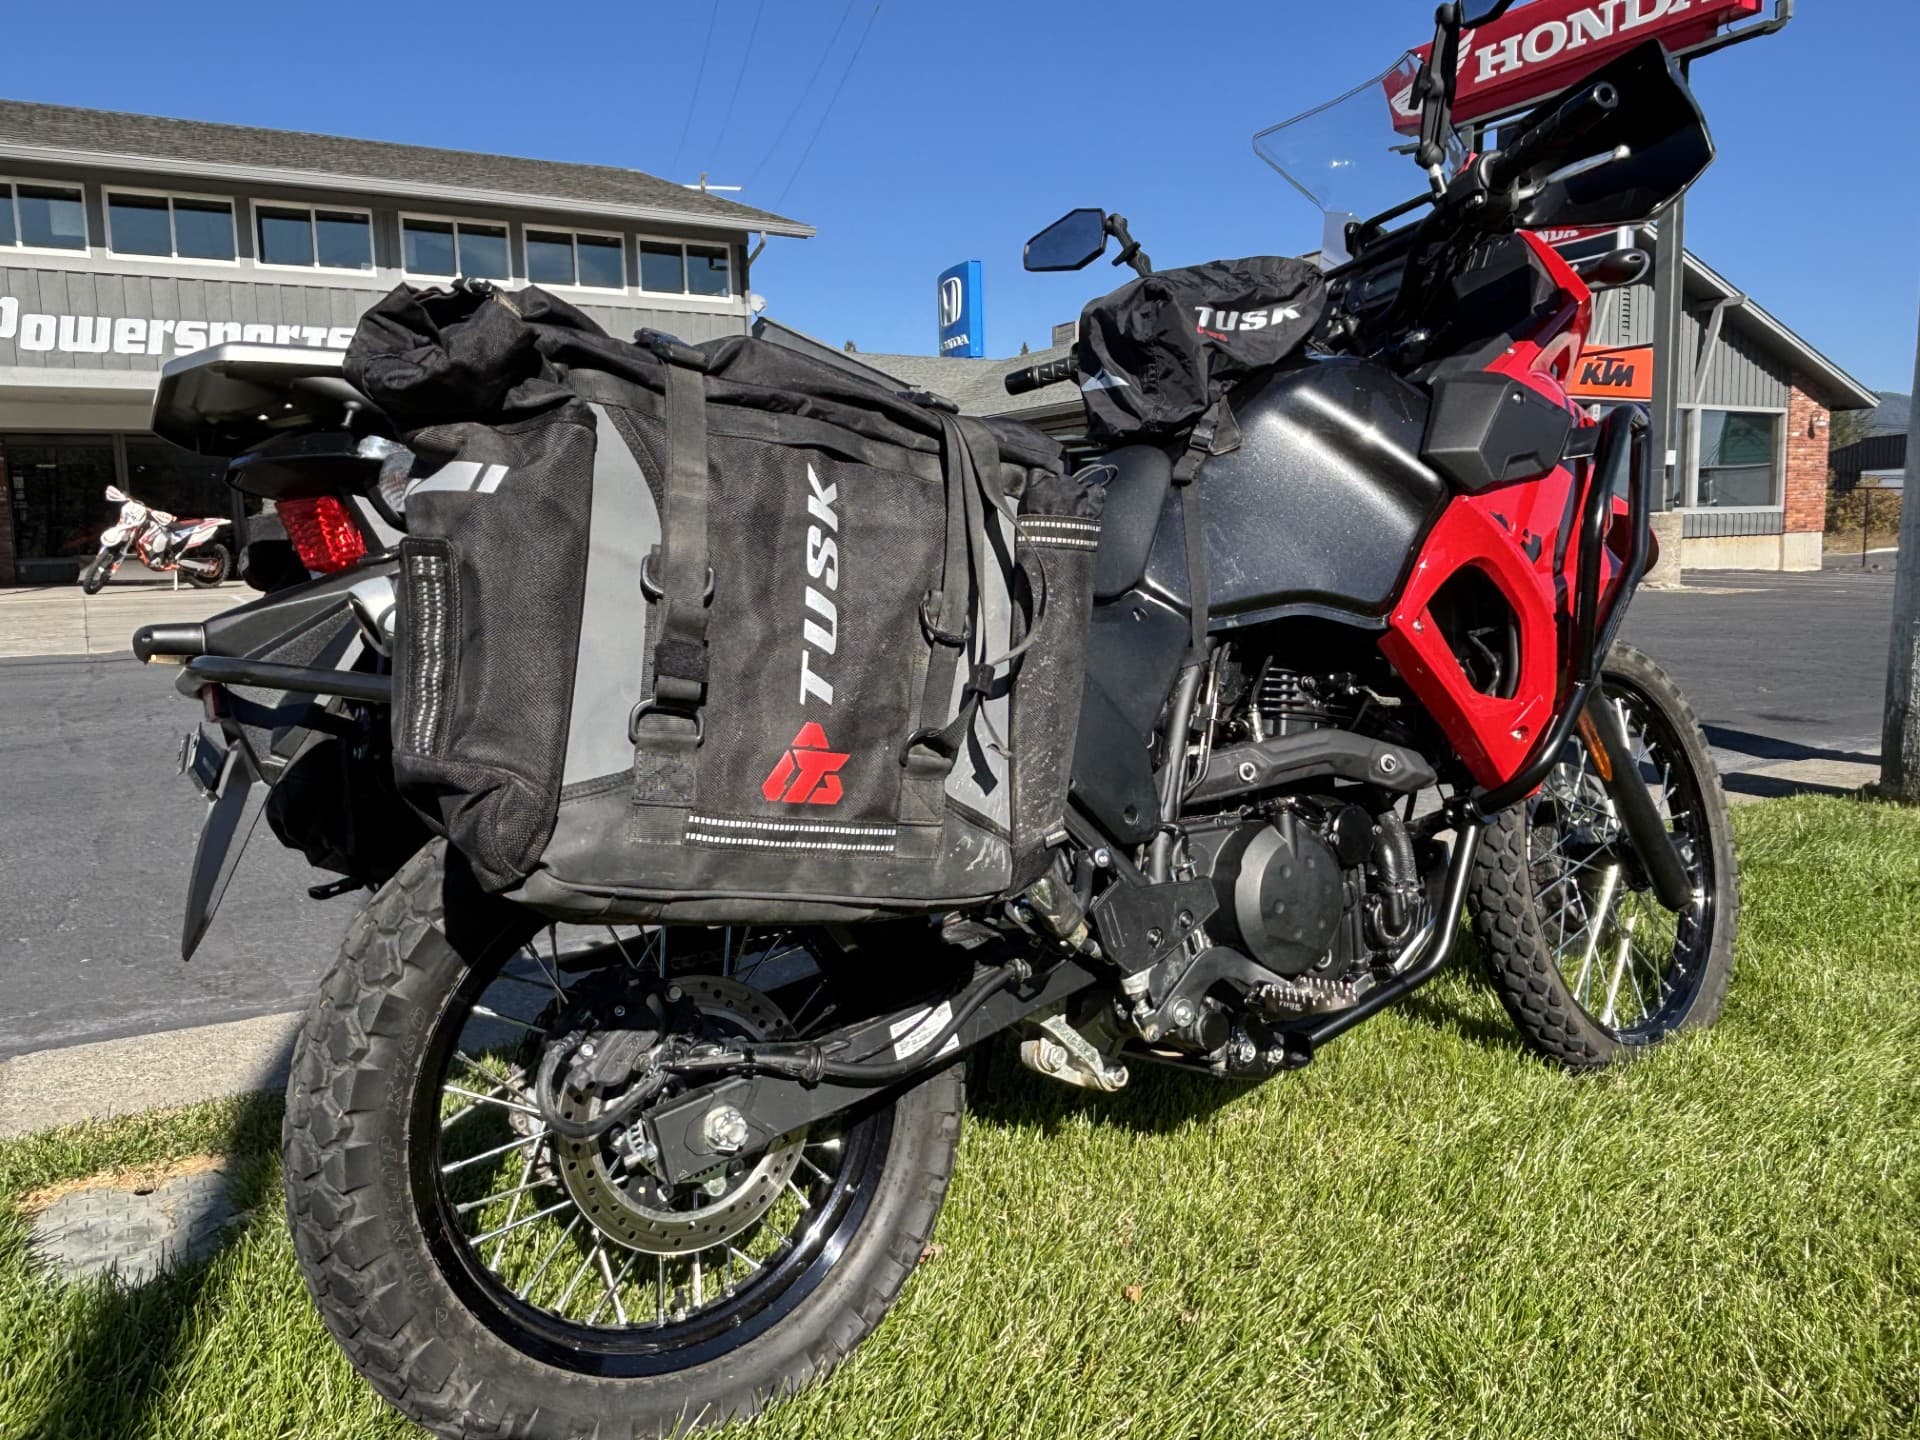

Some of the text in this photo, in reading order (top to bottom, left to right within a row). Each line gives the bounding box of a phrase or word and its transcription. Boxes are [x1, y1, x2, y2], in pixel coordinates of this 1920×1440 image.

[1535, 229, 1579, 243] NDA
[1194, 303, 1301, 331] TUSK
[1579, 356, 1635, 388] KTM
[800, 462, 839, 706] TUSK
